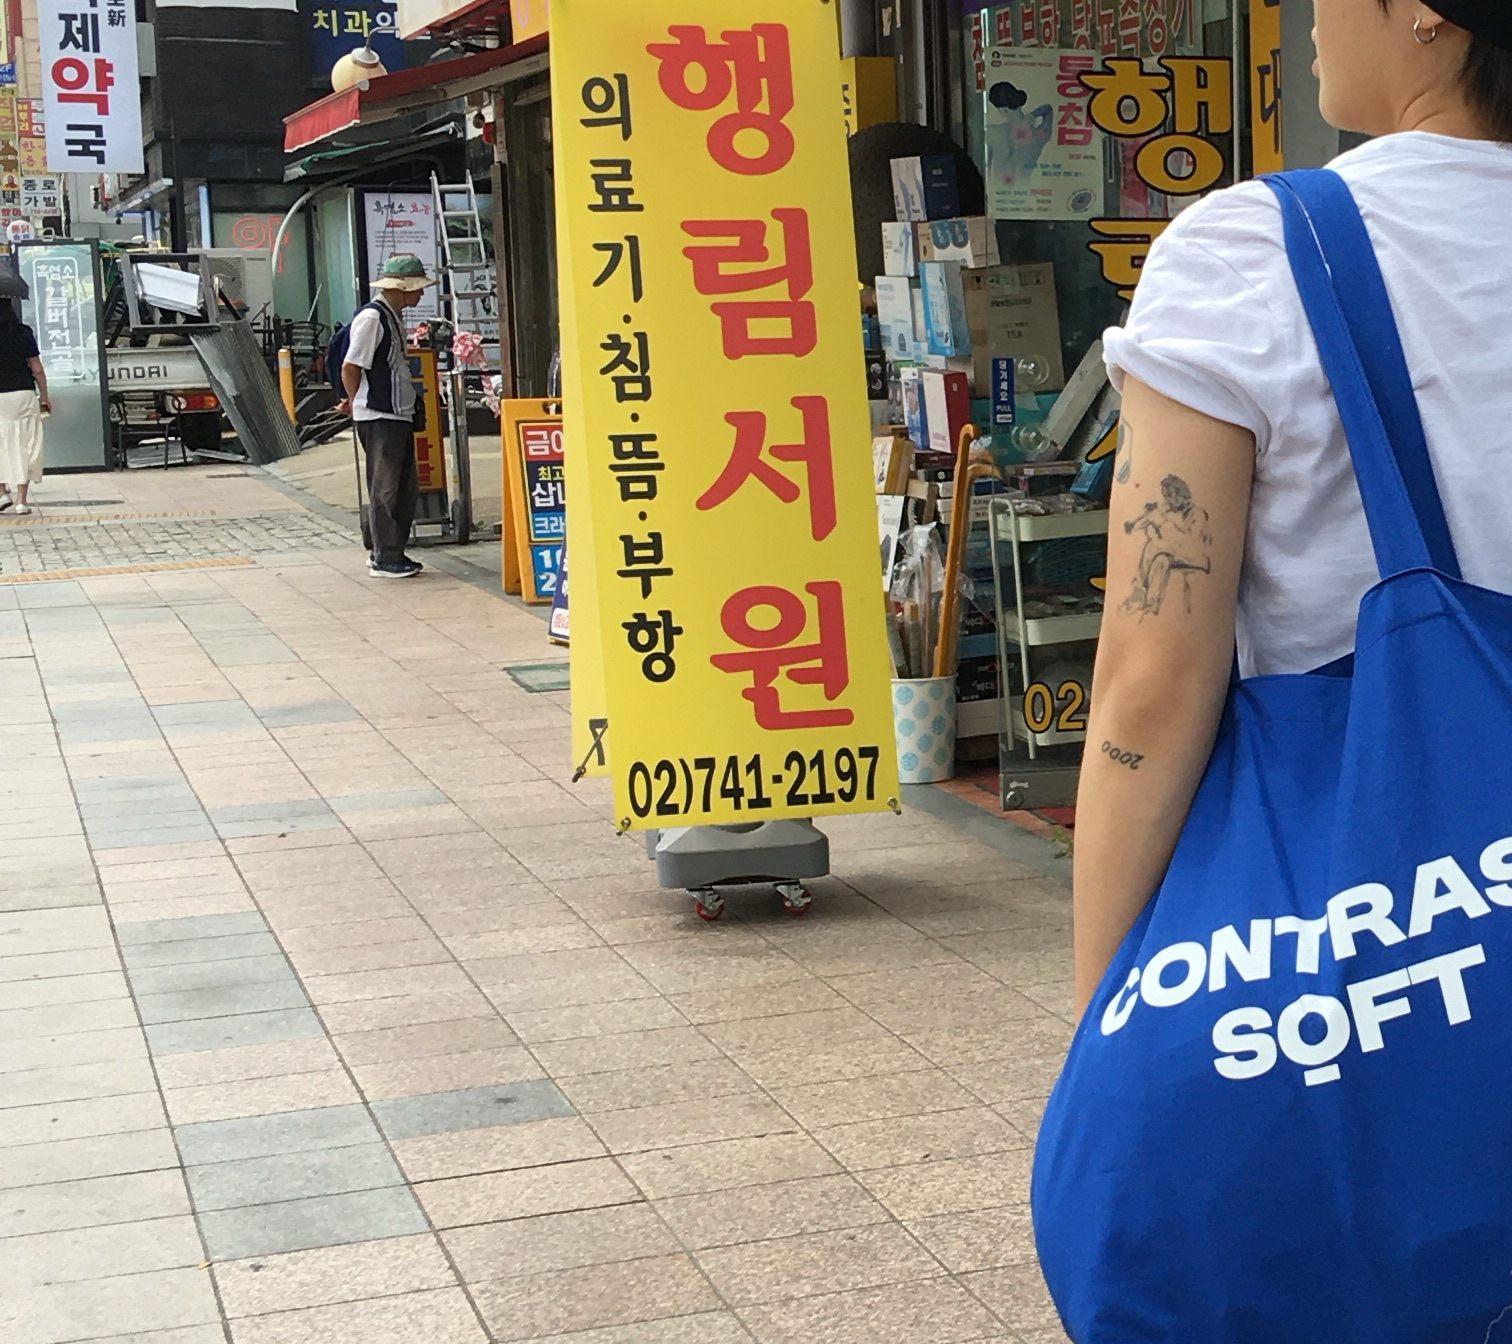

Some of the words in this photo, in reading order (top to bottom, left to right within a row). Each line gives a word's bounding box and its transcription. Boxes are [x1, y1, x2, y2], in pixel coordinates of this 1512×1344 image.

[313, 9, 410, 40] 치과의
[646, 23, 853, 730] 행림서원
[627, 746, 880, 818] 02)741-2197
[1101, 741, 1144, 770] 2000
[1213, 943, 1486, 1087] SOFT
